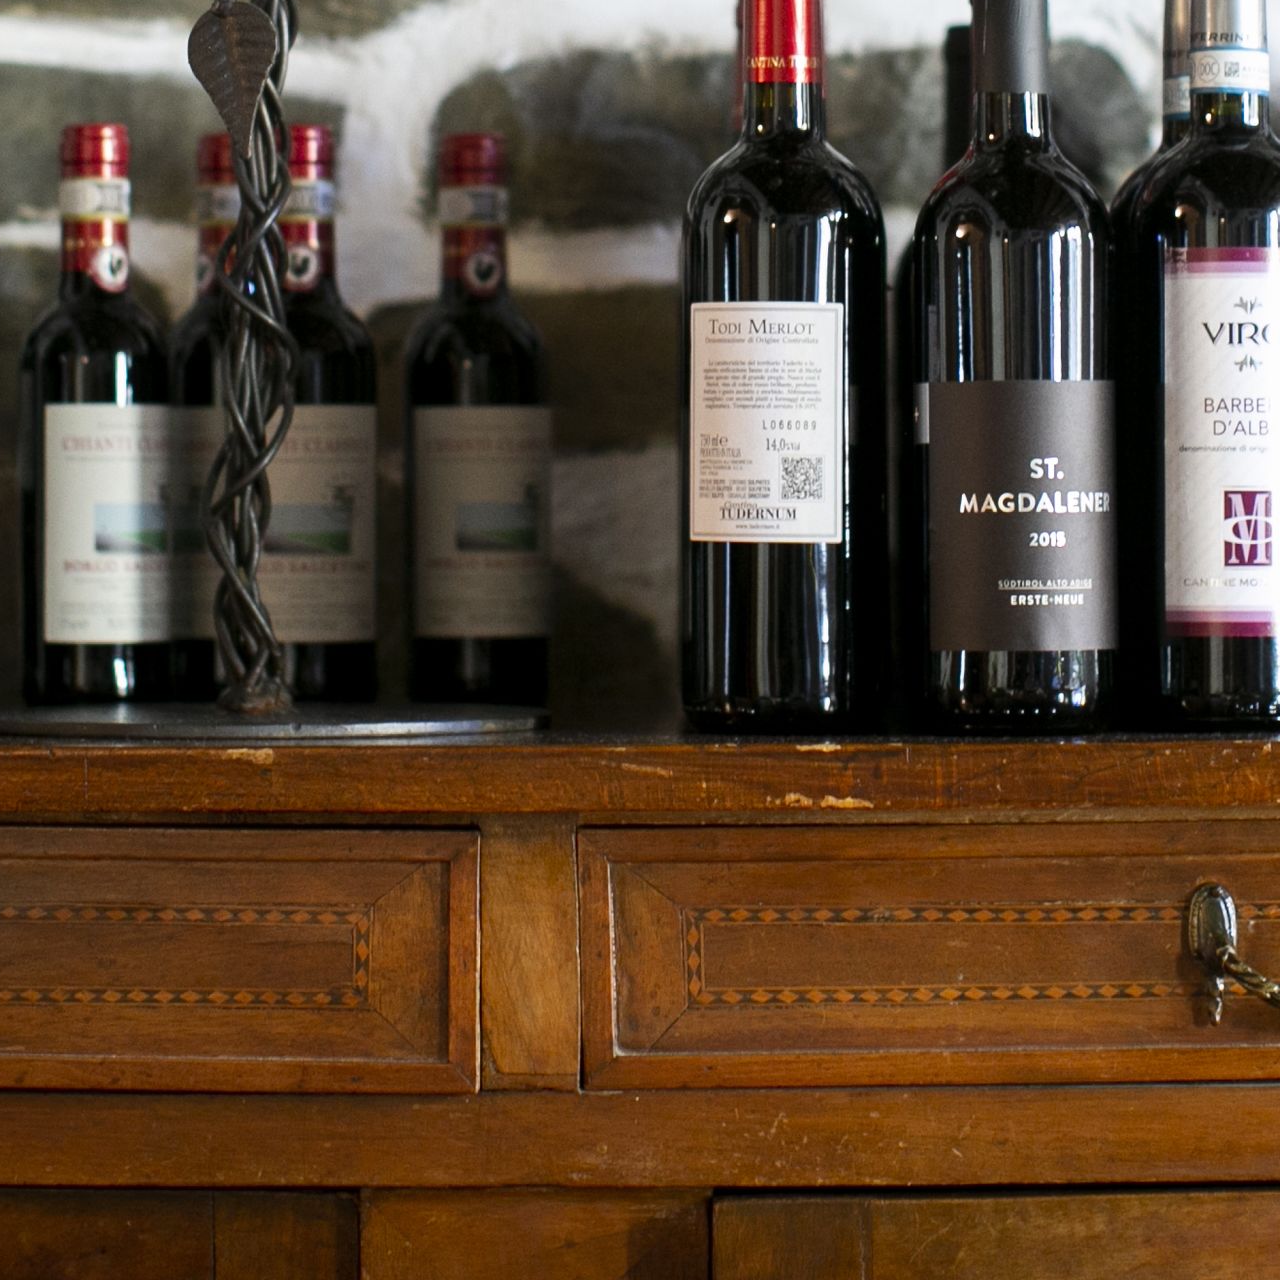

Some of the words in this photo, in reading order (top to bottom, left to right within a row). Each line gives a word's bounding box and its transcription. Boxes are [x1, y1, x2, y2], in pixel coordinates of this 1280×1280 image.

[748, 318, 816, 335] MERLOT
[762, 419, 817, 431] L066089
[1029, 457, 1065, 480] ST.
[959, 490, 1110, 514] MAGDALENER
[720, 508, 797, 521] TUDERNUM
[1029, 531, 1067, 548] 2015
[1045, 578, 1068, 588] ALTO
